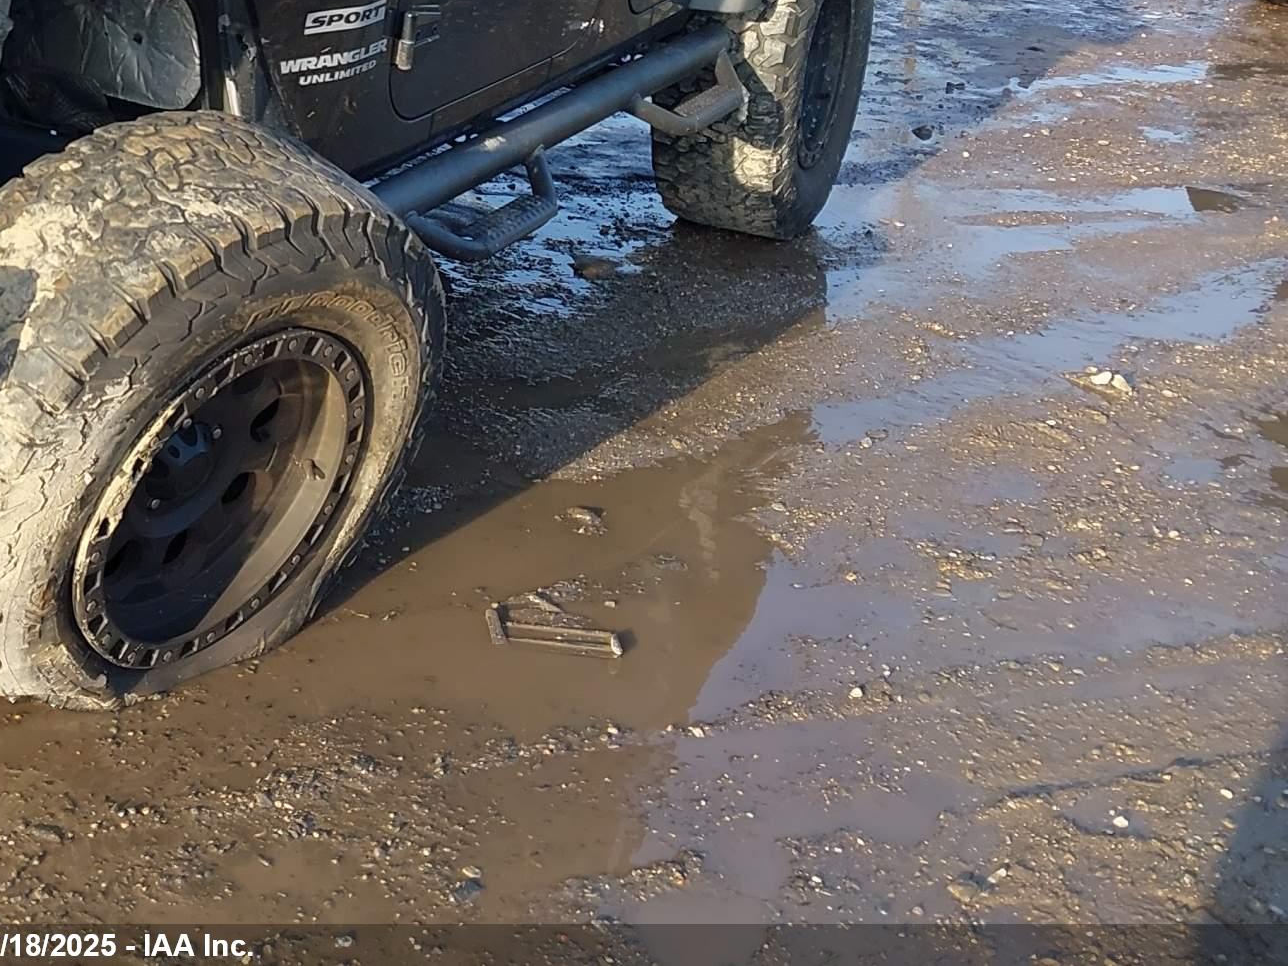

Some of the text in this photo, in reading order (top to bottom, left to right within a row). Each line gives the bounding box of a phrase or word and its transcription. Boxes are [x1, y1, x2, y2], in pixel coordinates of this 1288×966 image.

[309, 4, 384, 30] SPORT
[280, 39, 388, 74] WRANGLER
[299, 60, 377, 86] UNLIMITED
